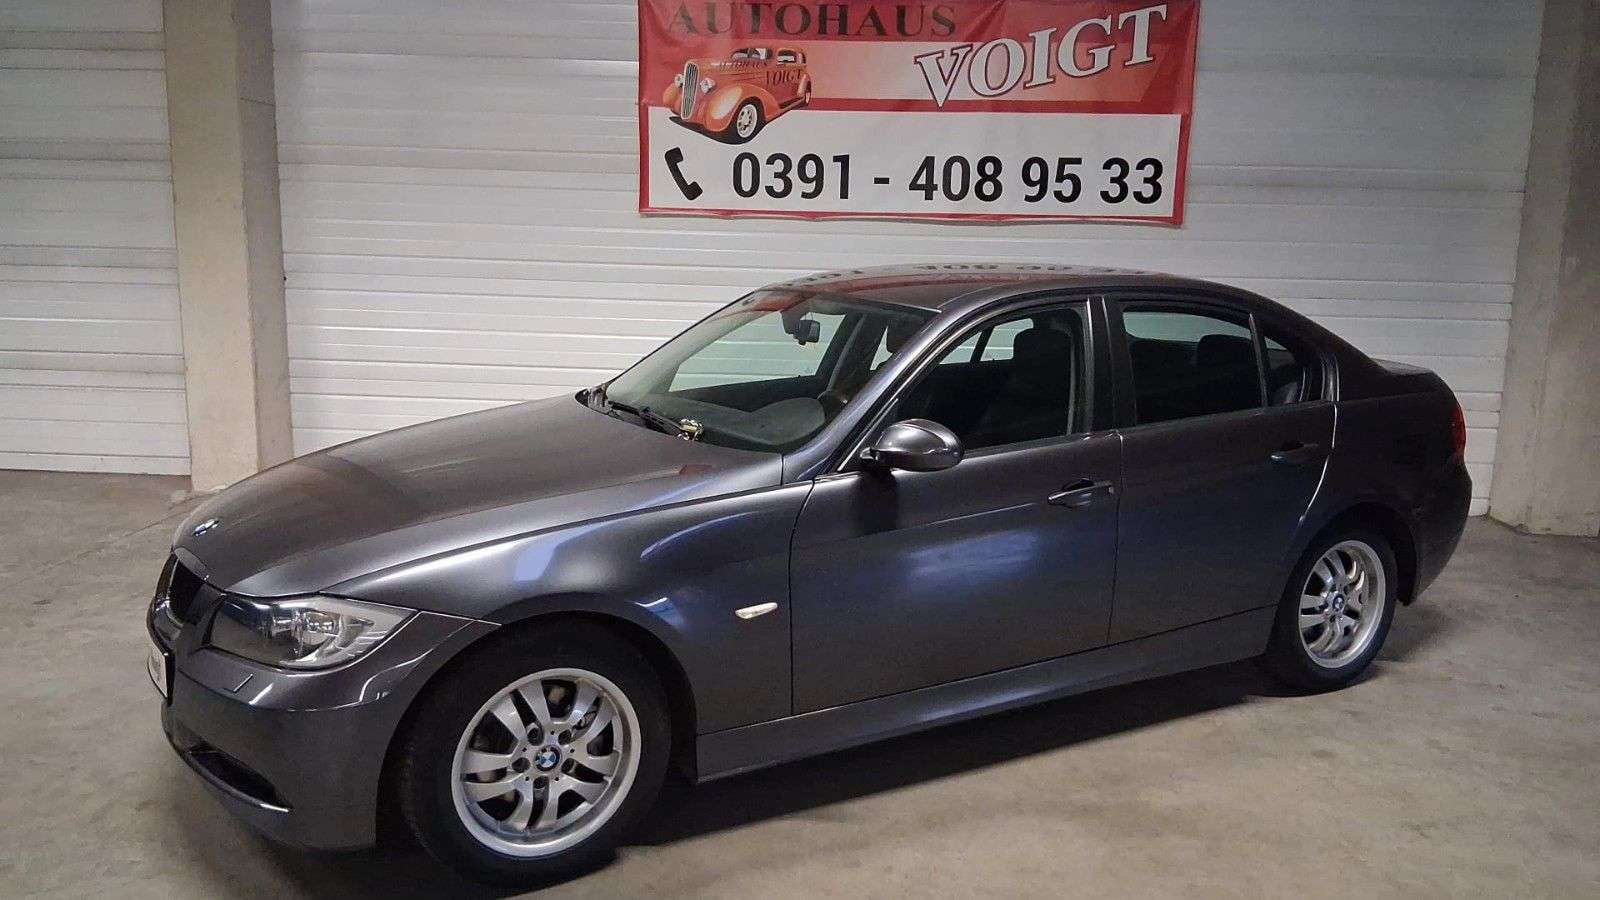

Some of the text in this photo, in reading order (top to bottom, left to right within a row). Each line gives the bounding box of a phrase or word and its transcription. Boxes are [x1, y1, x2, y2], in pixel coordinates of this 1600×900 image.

[669, 1, 956, 37] AUTOHAUS
[914, 4, 1168, 107] VOIGT
[732, 152, 850, 200] 0391
[908, 155, 1003, 202] 408
[1021, 156, 1083, 203] 95
[1099, 157, 1164, 204] 33
